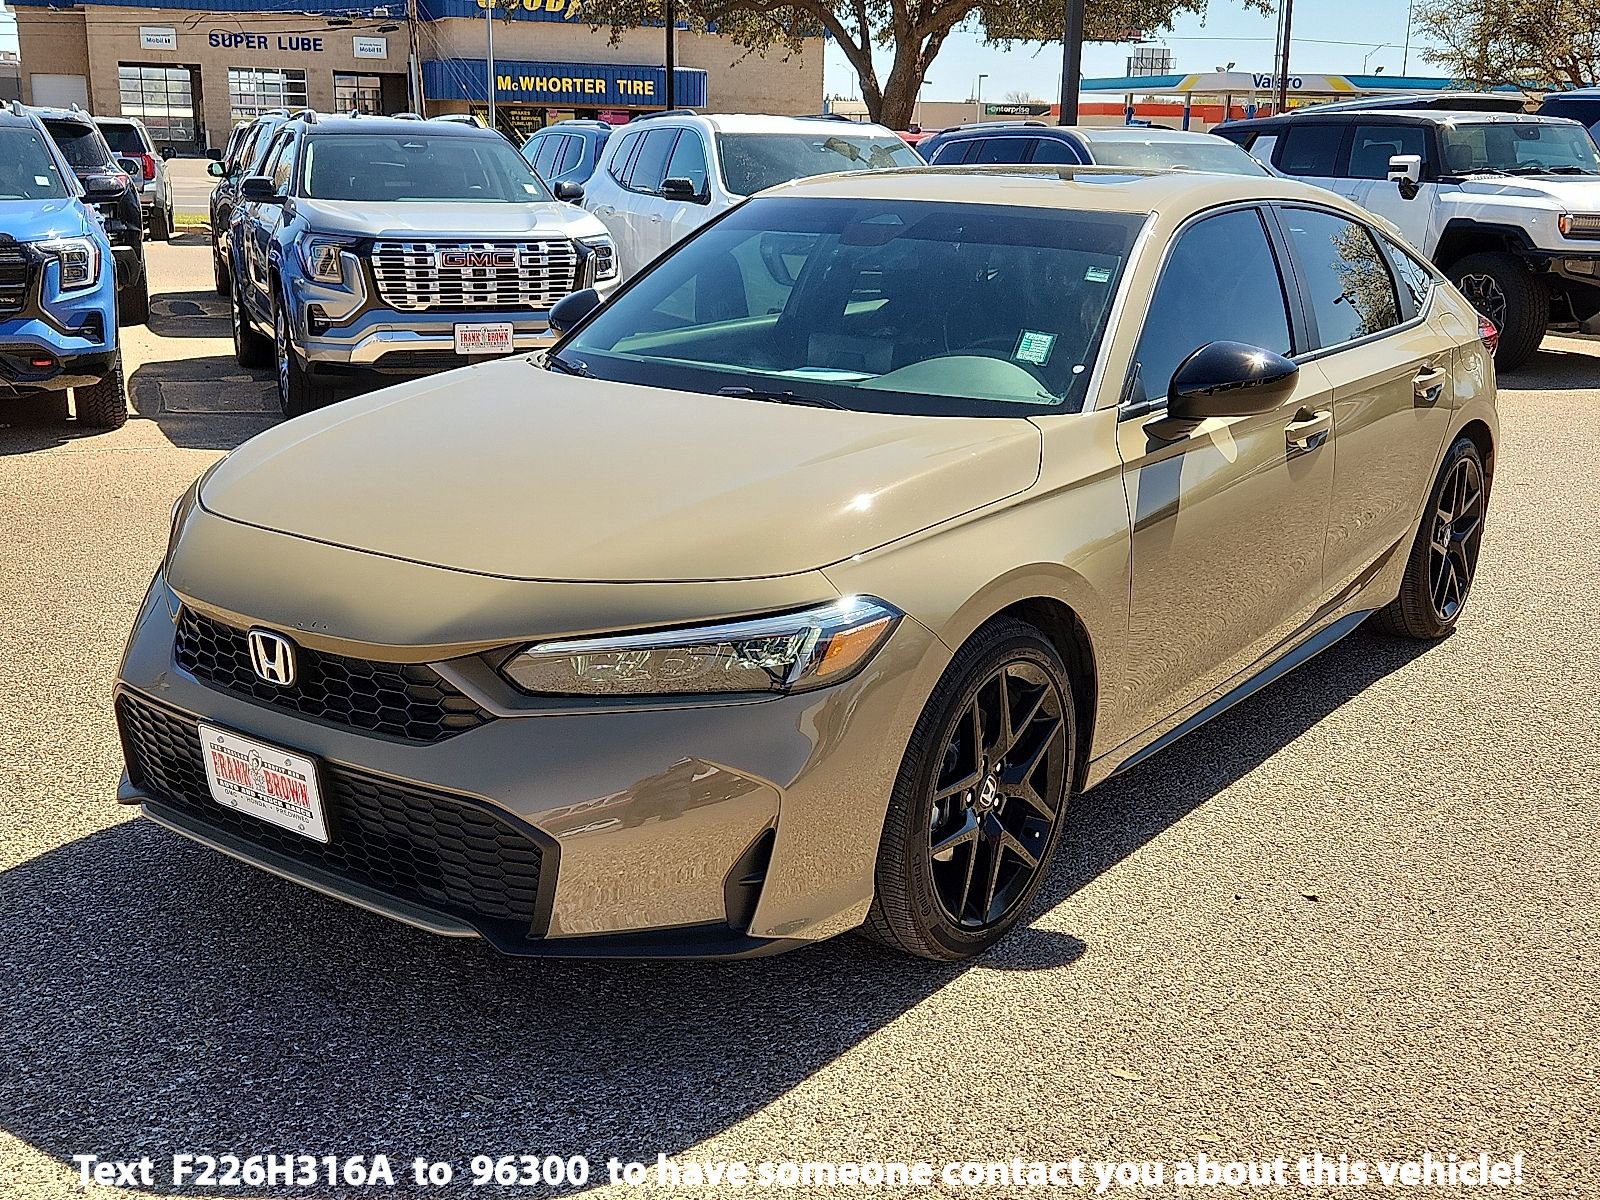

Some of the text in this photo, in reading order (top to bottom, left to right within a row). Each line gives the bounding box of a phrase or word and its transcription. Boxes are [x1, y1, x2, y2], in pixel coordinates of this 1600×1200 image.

[208, 33, 324, 52] SUPER LUBE
[497, 75, 655, 95] McWHORTER TIRE
[442, 252, 516, 268] GMC
[460, 332, 509, 343] FRANK BROWN
[211, 750, 311, 810] FRANK BROWN
[241, 788, 256, 797] AND
[257, 793, 282, 806] TRUCK
[246, 796, 267, 808] HONDA
